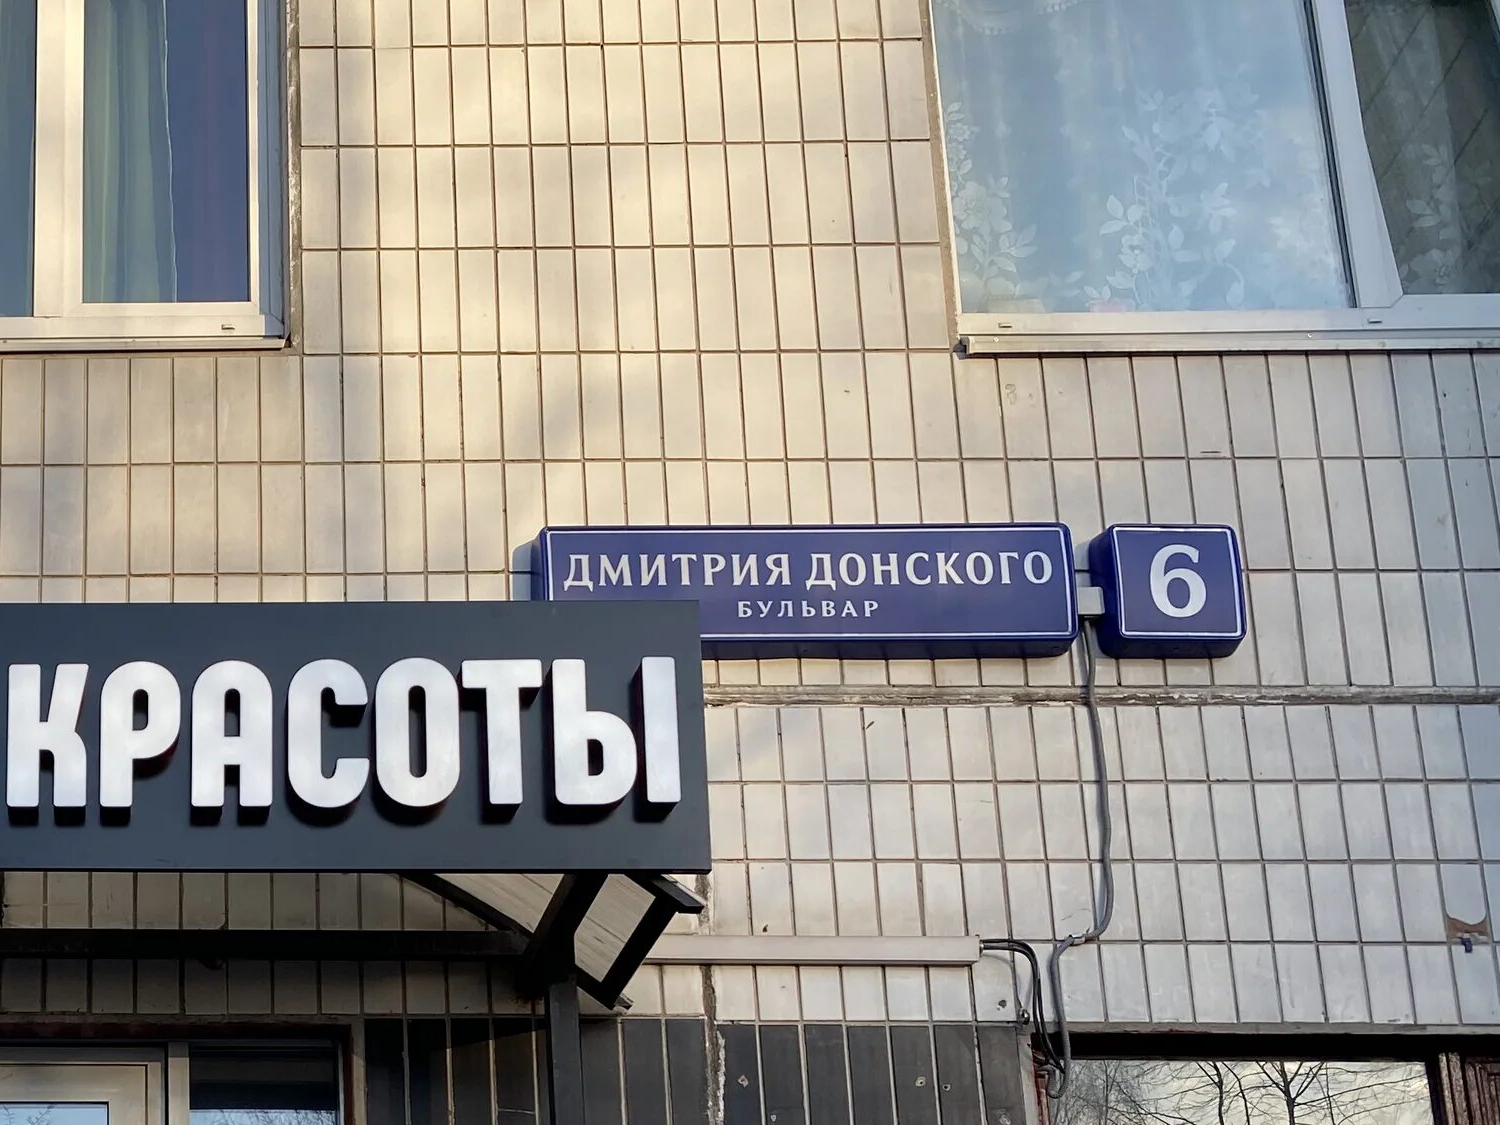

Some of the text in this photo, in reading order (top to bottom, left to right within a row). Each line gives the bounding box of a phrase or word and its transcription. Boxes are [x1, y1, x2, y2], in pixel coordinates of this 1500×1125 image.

[563, 549, 1053, 593] ДМИТРИЯ ДОНСКОГО
[1148, 543, 1208, 618] 6
[736, 598, 881, 619] БУЛЬВАР
[6, 656, 682, 808] КРАСОТЫ
